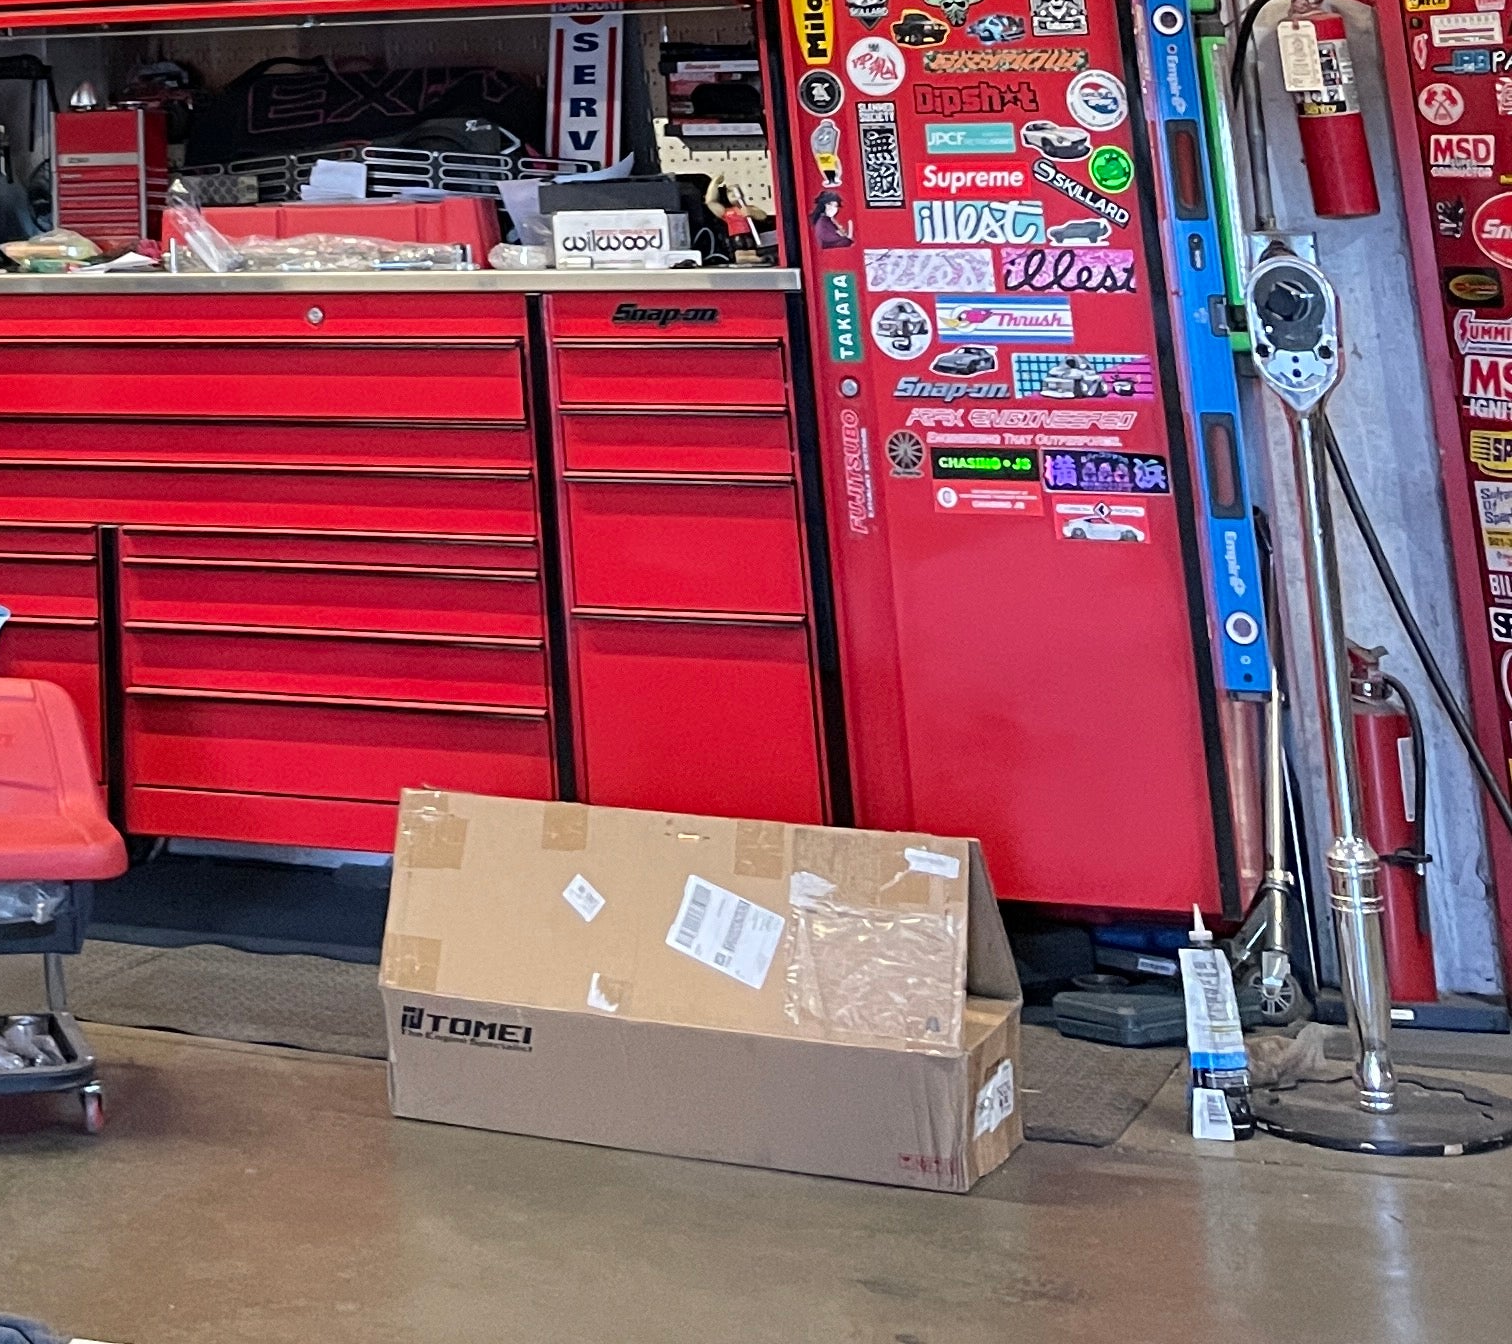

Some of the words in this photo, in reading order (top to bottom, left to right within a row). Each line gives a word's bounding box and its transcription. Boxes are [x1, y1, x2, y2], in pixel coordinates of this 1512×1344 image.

[568, 32, 601, 172] SERV
[1433, 137, 1491, 163] MSD
[922, 165, 1025, 194] Supreme
[1053, 173, 1130, 224] SKILLARD
[919, 200, 1043, 243] illest
[562, 228, 663, 252] wilwood
[1004, 248, 1137, 292] illest
[612, 303, 719, 328] Snap-on
[833, 274, 855, 360] TAKATA
[995, 311, 1065, 327] Thrush
[893, 376, 1011, 402] Snap-on
[840, 408, 869, 534] FUJITSUBO
[426, 1013, 533, 1044] TOMEI
